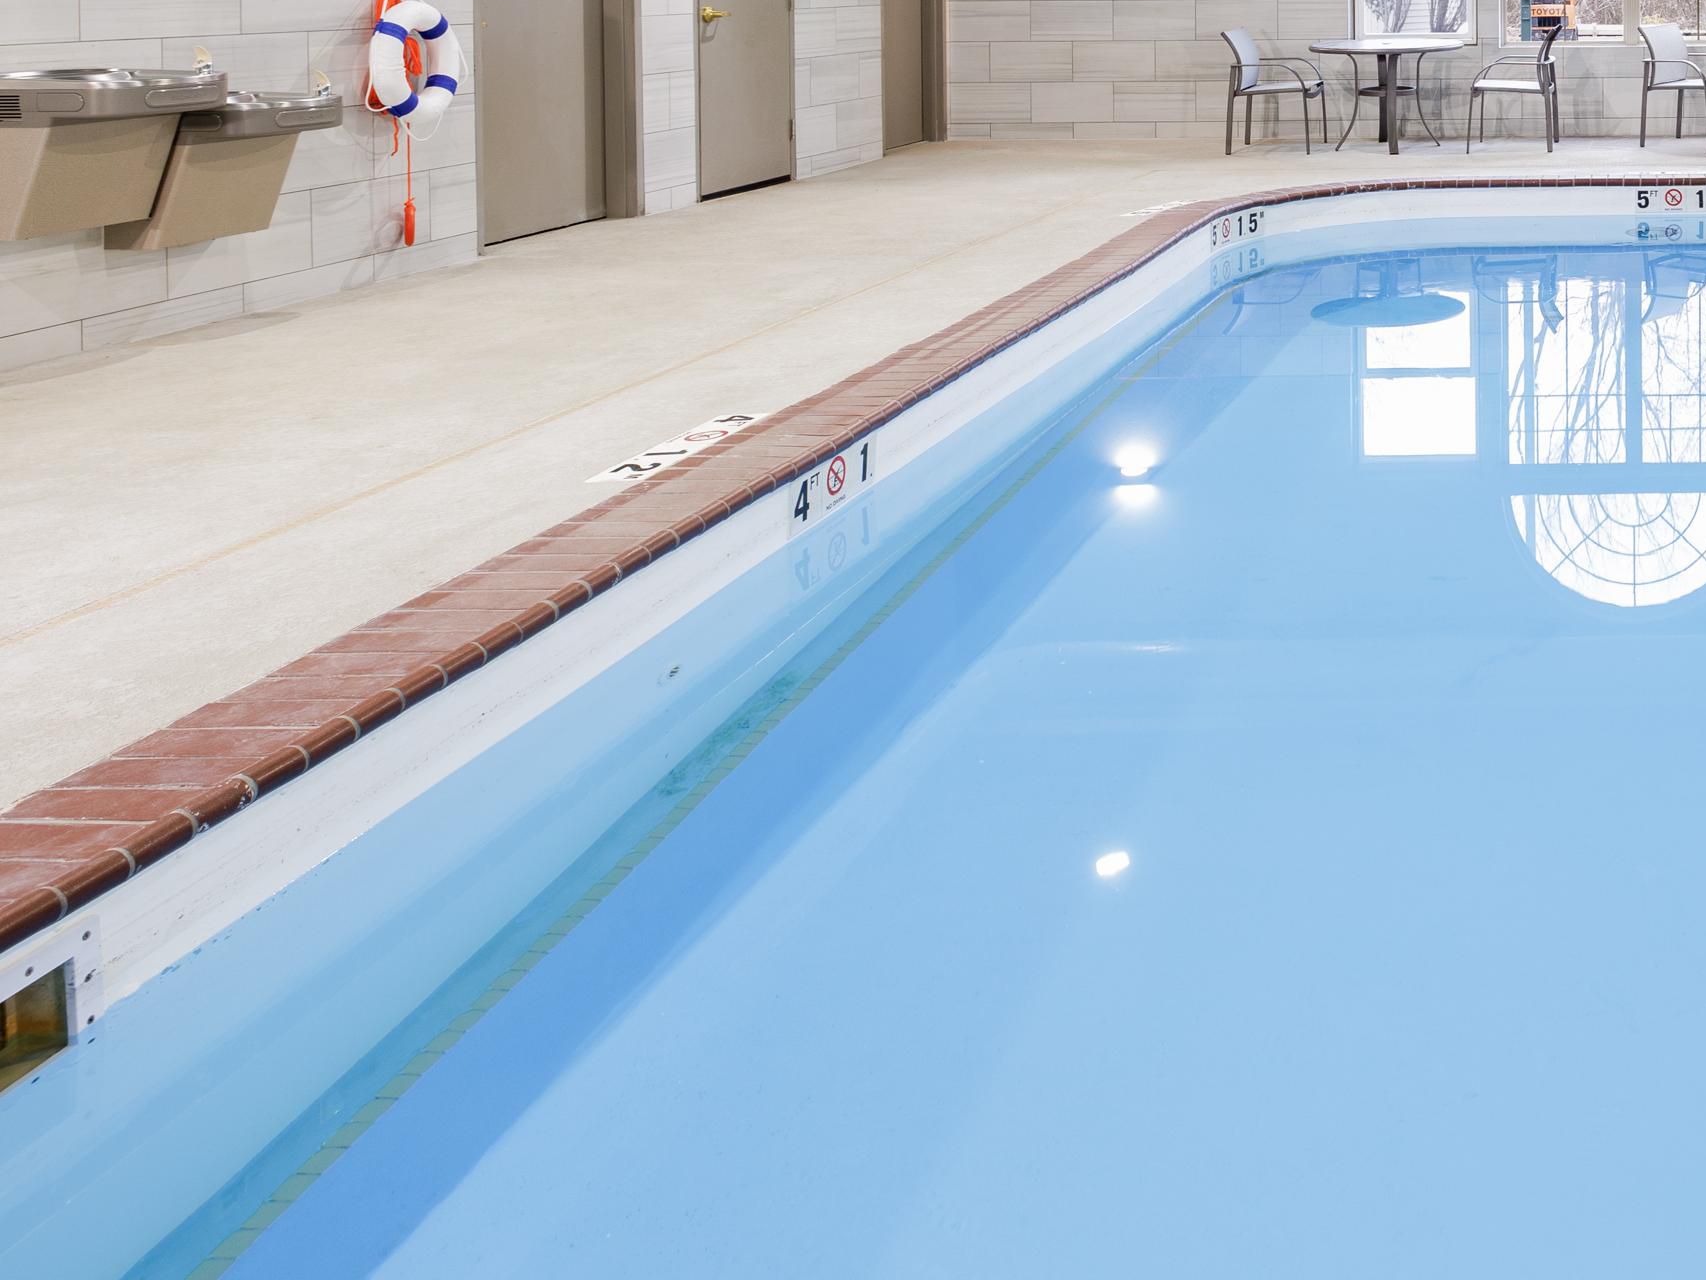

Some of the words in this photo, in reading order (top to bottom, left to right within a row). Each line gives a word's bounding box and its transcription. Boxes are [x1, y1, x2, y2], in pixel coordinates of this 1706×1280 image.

[1532, 8, 1566, 16] TOYOTA
[1637, 190, 1649, 209] 5
[794, 479, 810, 522] 4
